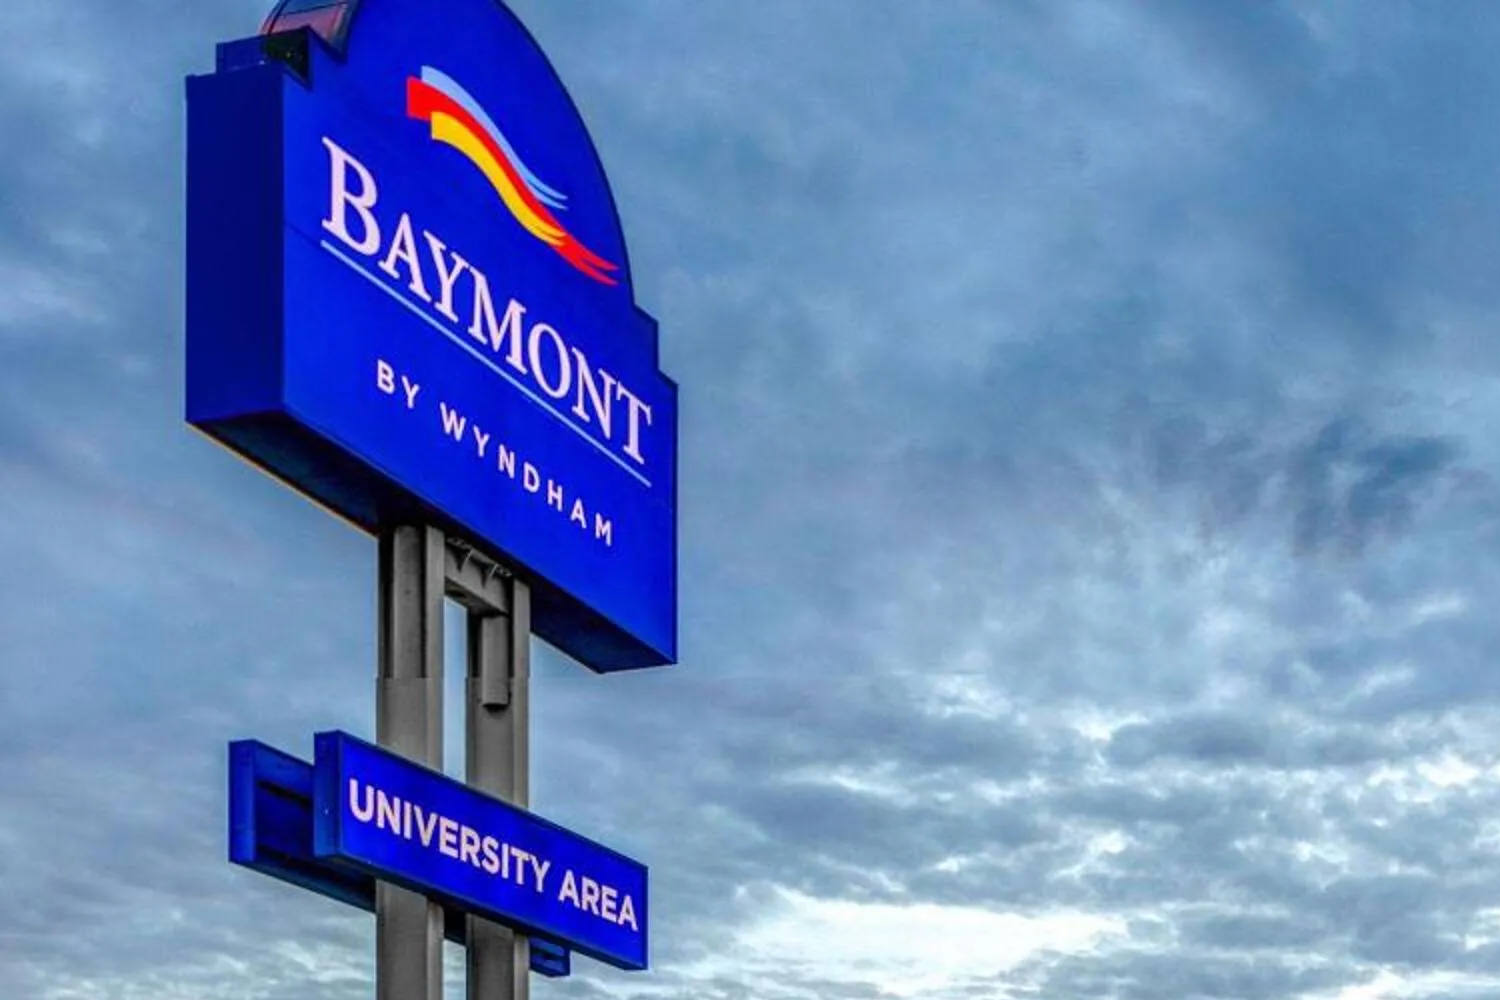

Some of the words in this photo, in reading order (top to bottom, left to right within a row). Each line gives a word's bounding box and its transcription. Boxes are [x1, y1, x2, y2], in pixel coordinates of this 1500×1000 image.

[321, 136, 652, 464] BAYMONT
[377, 359, 420, 409] BY
[440, 402, 613, 547] WYNDHAM
[349, 777, 551, 893] UNIVERSITY
[558, 869, 638, 932] AREA
